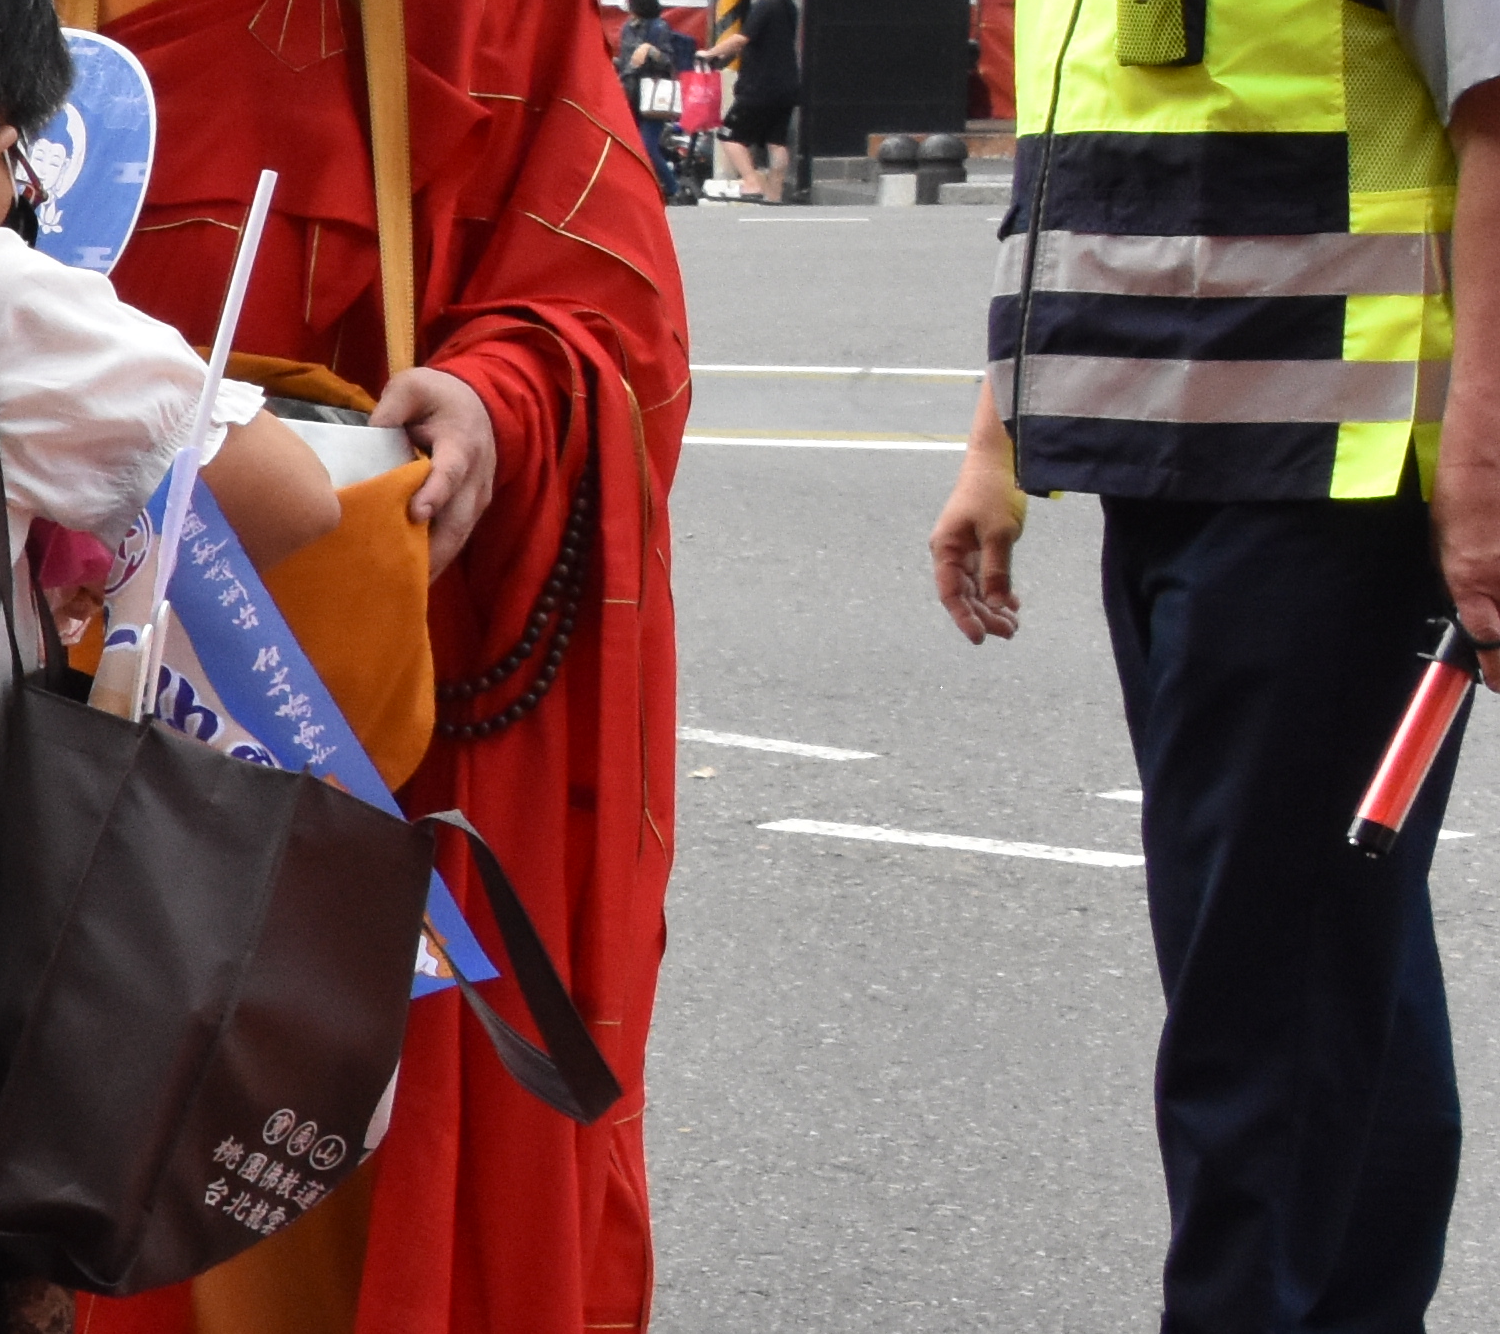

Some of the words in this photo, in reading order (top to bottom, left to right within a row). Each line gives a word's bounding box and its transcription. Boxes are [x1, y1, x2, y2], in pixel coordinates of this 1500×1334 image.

[204, 1176, 296, 1236] 台北龍雲
[212, 1135, 334, 1210] 桃園佛教蓮
